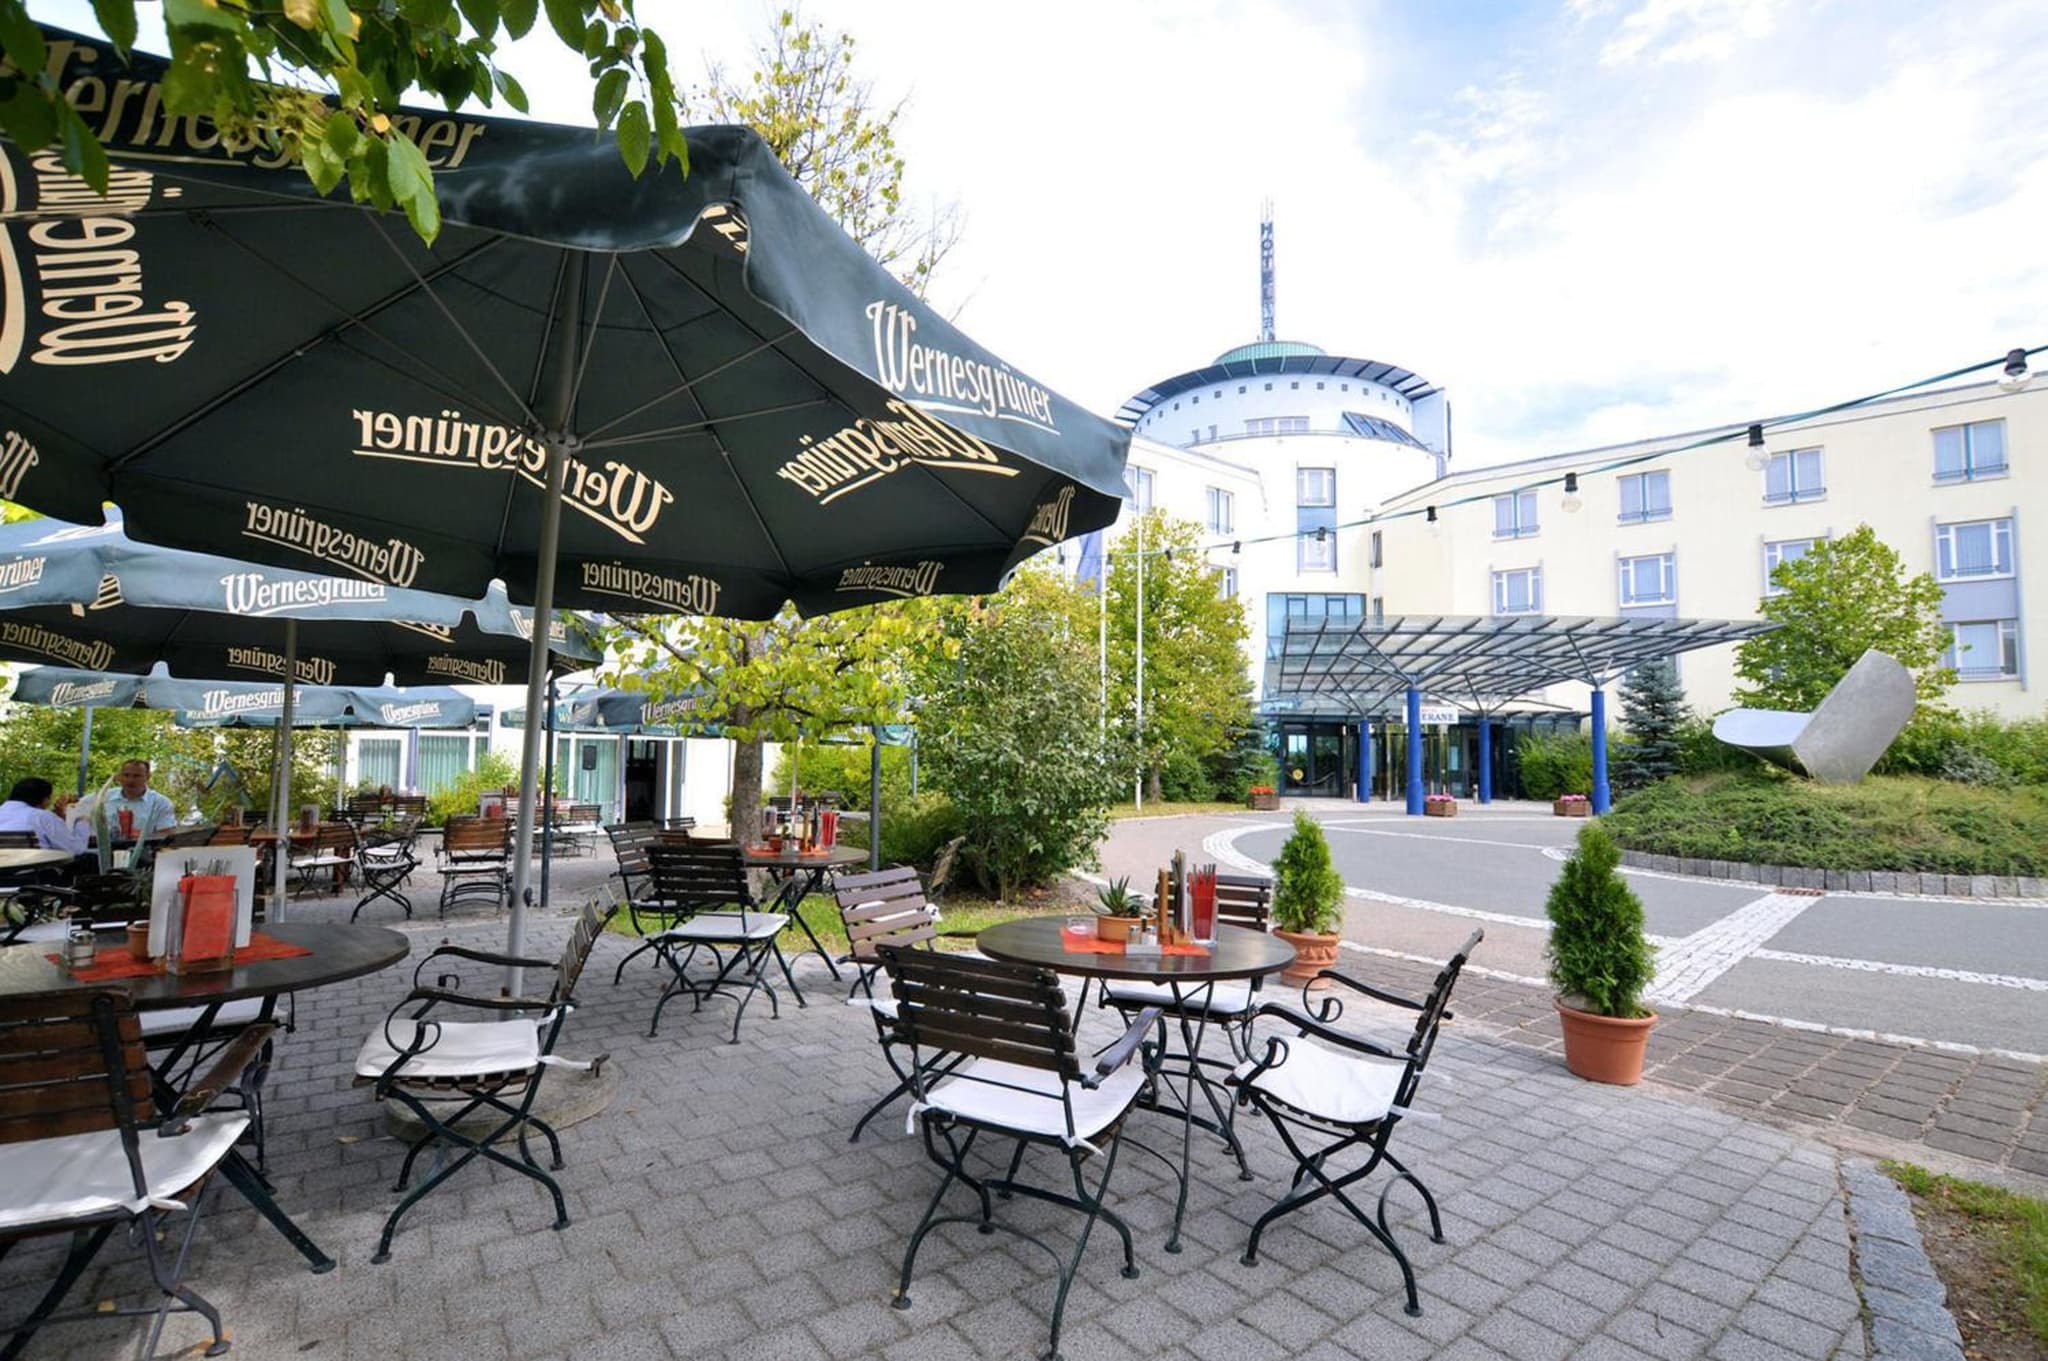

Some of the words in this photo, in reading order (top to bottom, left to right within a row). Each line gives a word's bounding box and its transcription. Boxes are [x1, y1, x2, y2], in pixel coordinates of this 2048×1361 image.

[866, 300, 1056, 427] Wernesgrüner
[202, 687, 302, 714] Wernesgrür
[1421, 713, 1456, 721] ERANE
